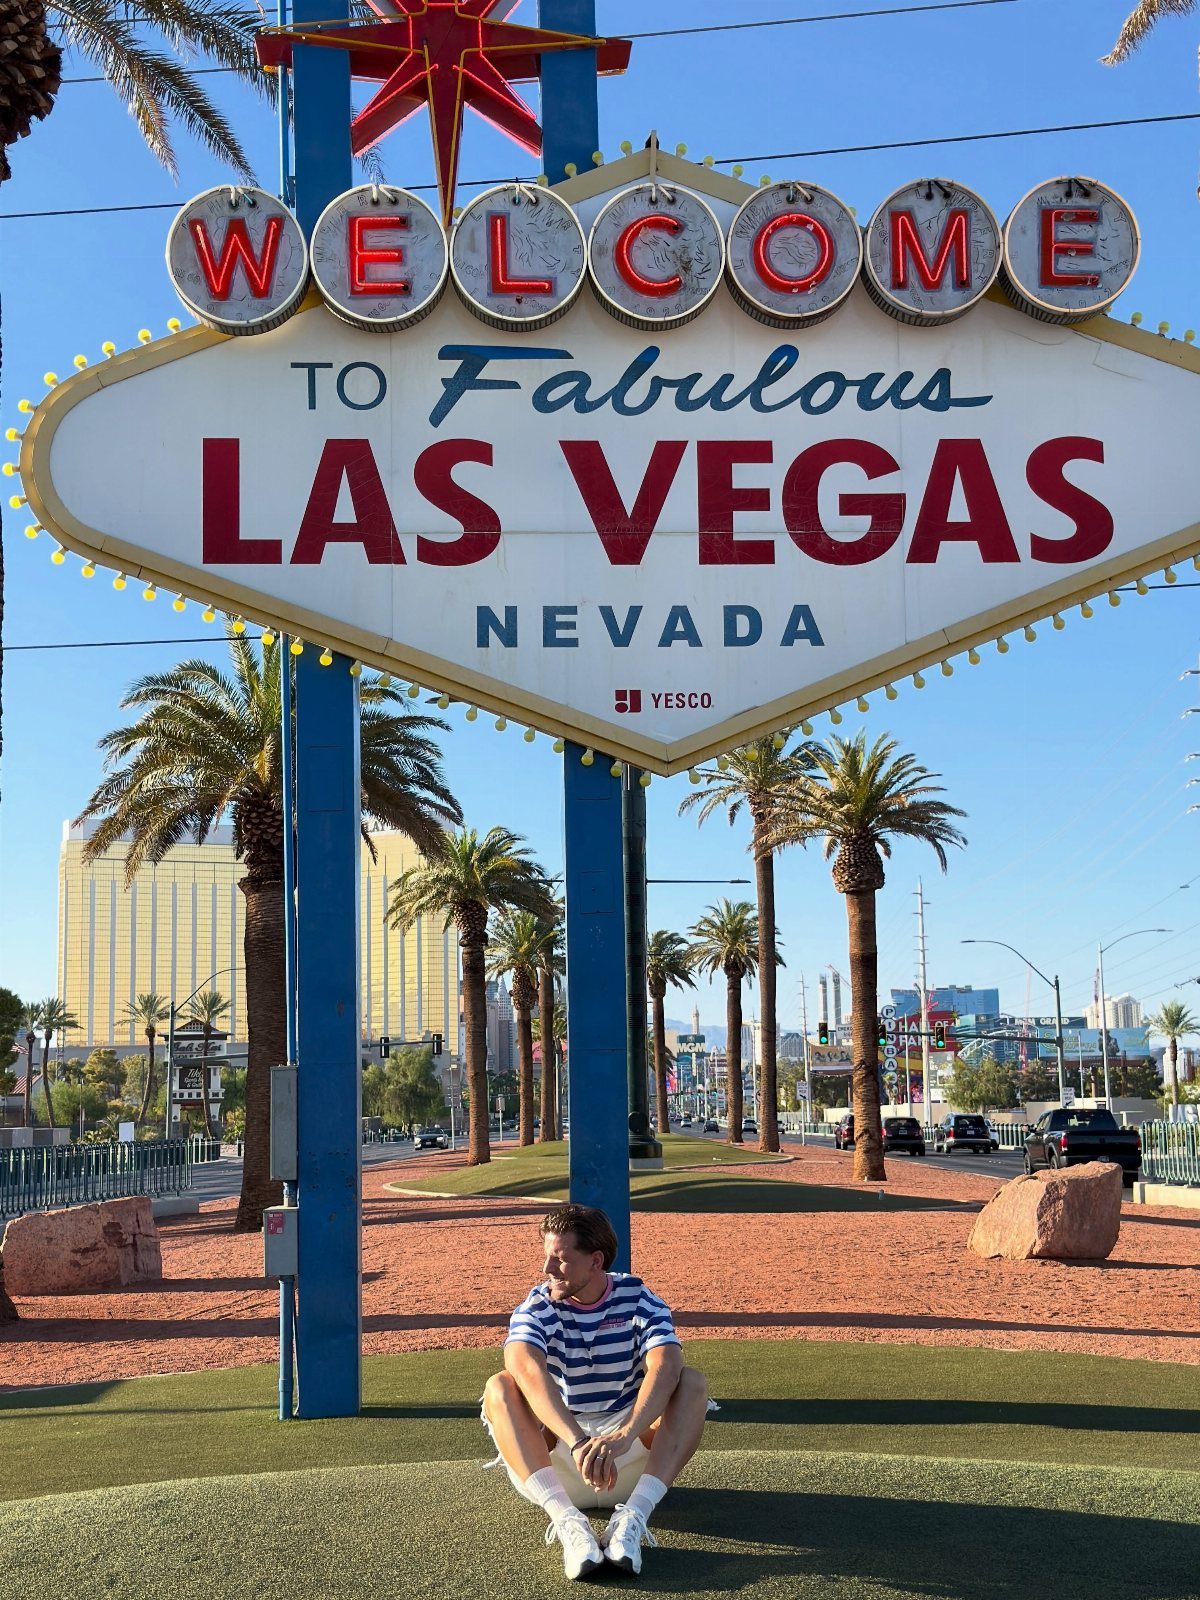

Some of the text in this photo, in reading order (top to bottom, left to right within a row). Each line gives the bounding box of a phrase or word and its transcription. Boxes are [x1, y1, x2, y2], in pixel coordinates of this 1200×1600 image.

[189, 207, 1101, 302] WELCOME
[290, 344, 993, 428] TO Fabulous
[202, 436, 1115, 567] LAS VEGAS
[476, 604, 825, 648] NEVADA
[651, 692, 712, 709] YESCO
[677, 1042, 706, 1052] MGM
